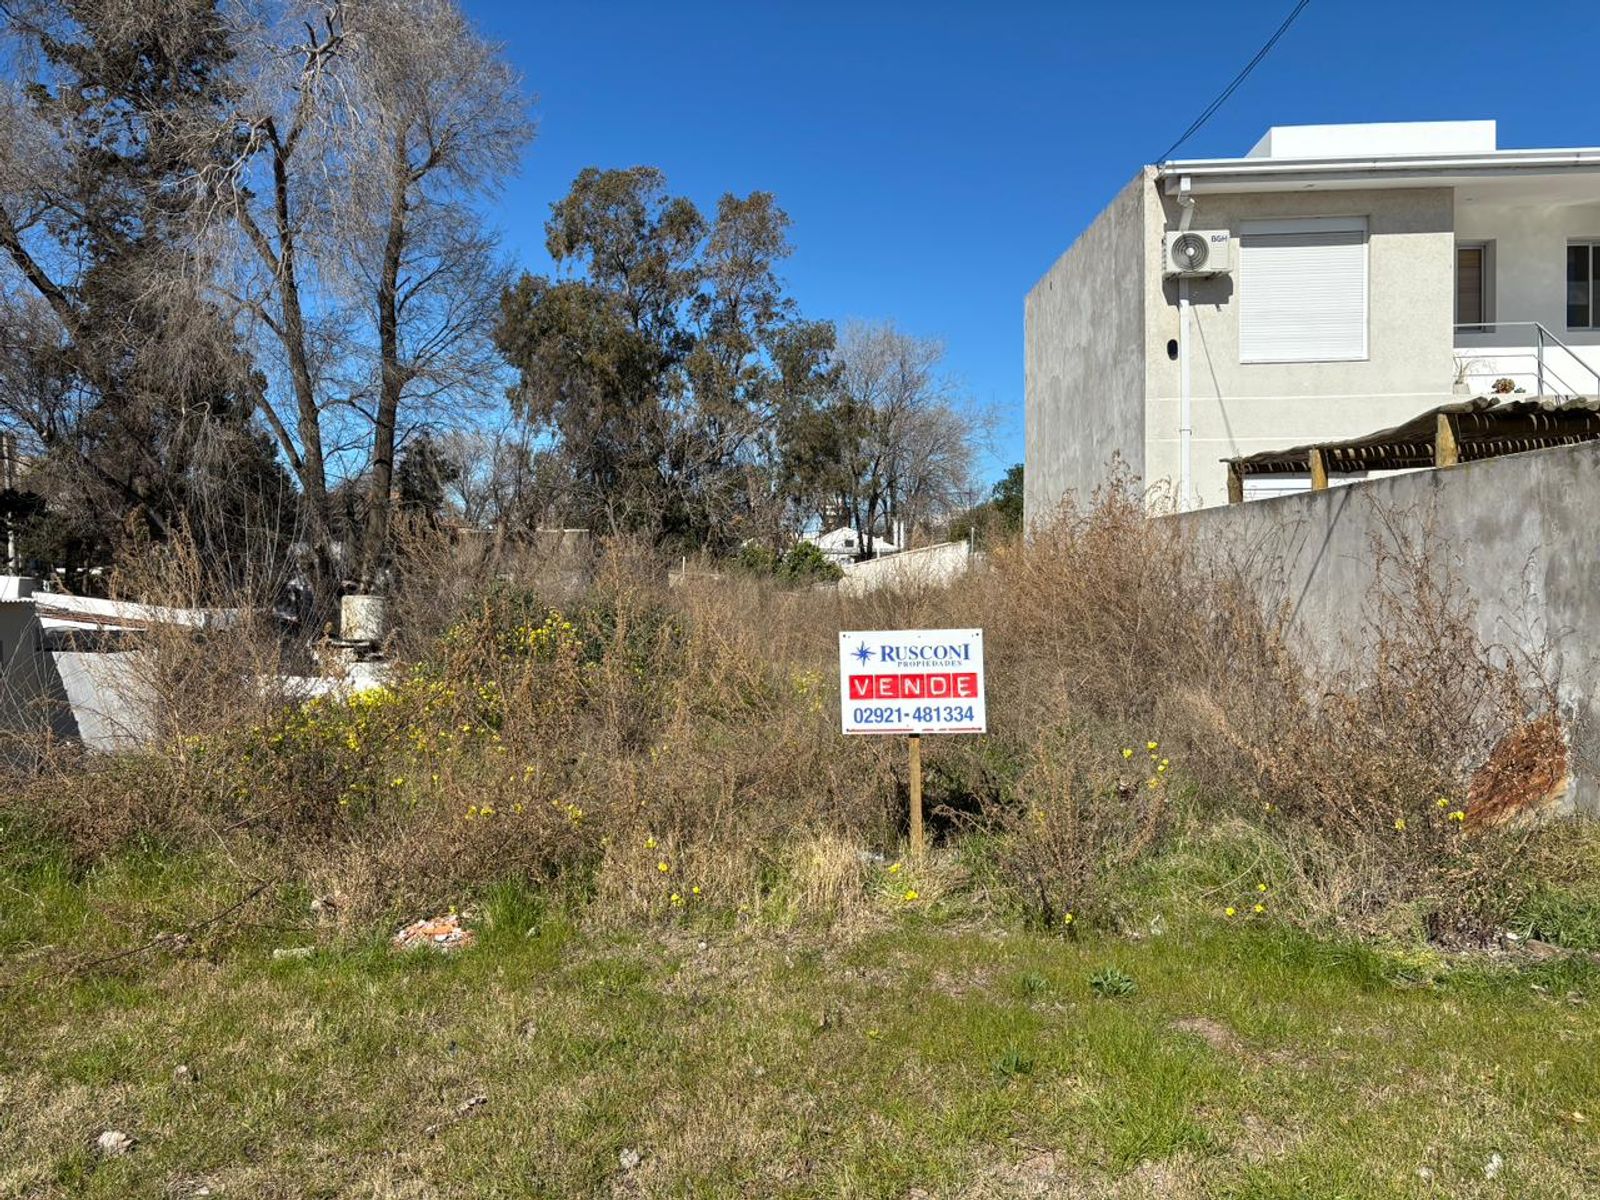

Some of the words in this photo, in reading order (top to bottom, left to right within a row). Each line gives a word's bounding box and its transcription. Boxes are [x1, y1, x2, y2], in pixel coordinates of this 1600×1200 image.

[1211, 235, 1228, 243] BGH
[880, 643, 970, 662] RUSCONI
[898, 660, 963, 668] PROPIEDADES
[854, 676, 971, 697] VENDE
